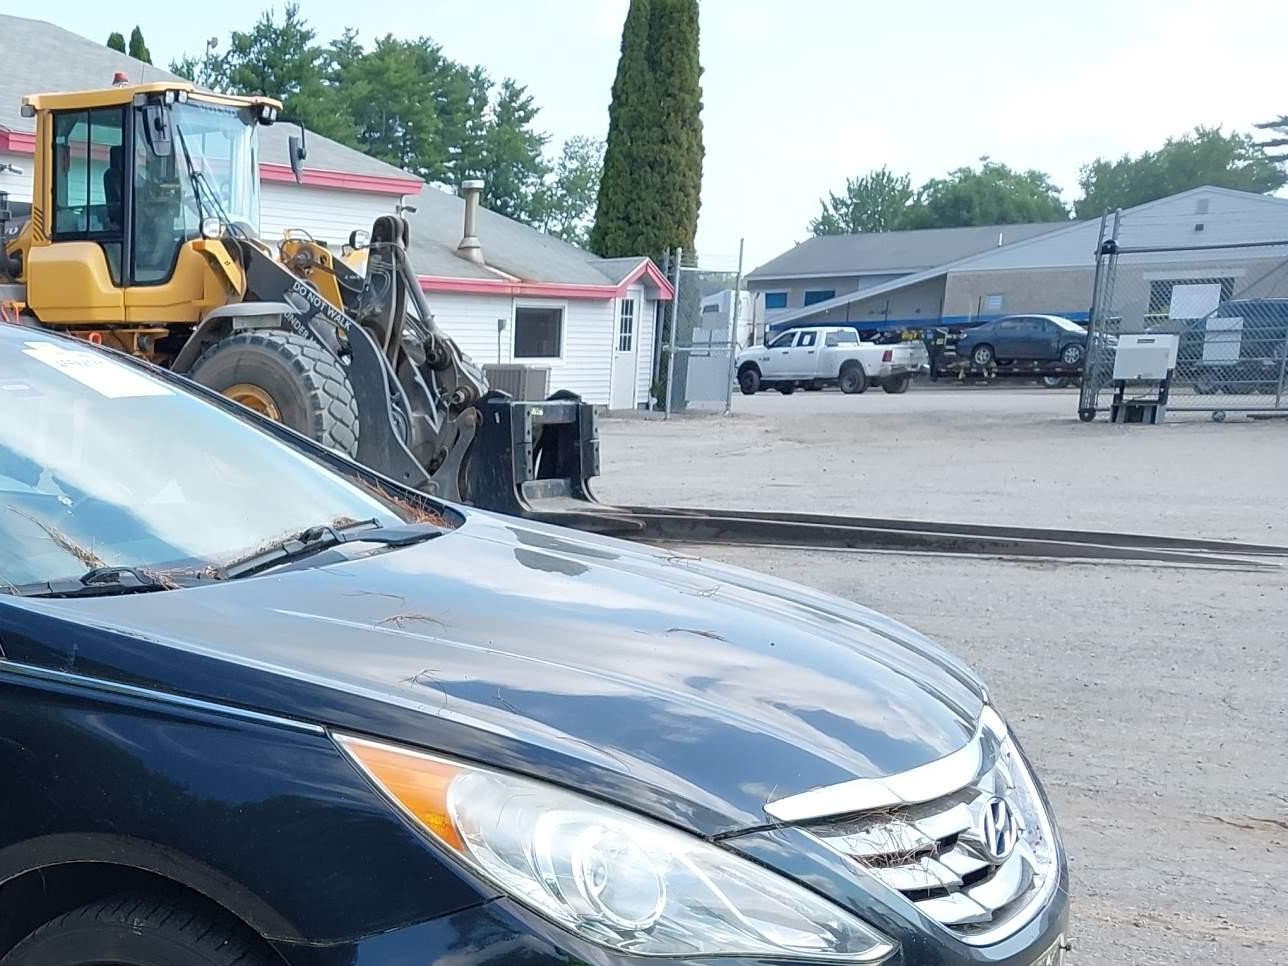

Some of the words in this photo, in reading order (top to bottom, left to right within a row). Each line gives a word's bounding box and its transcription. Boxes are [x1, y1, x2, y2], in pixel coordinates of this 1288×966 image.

[292, 281, 307, 295] DO
[306, 291, 327, 312] NOT
[326, 306, 352, 332] WALK
